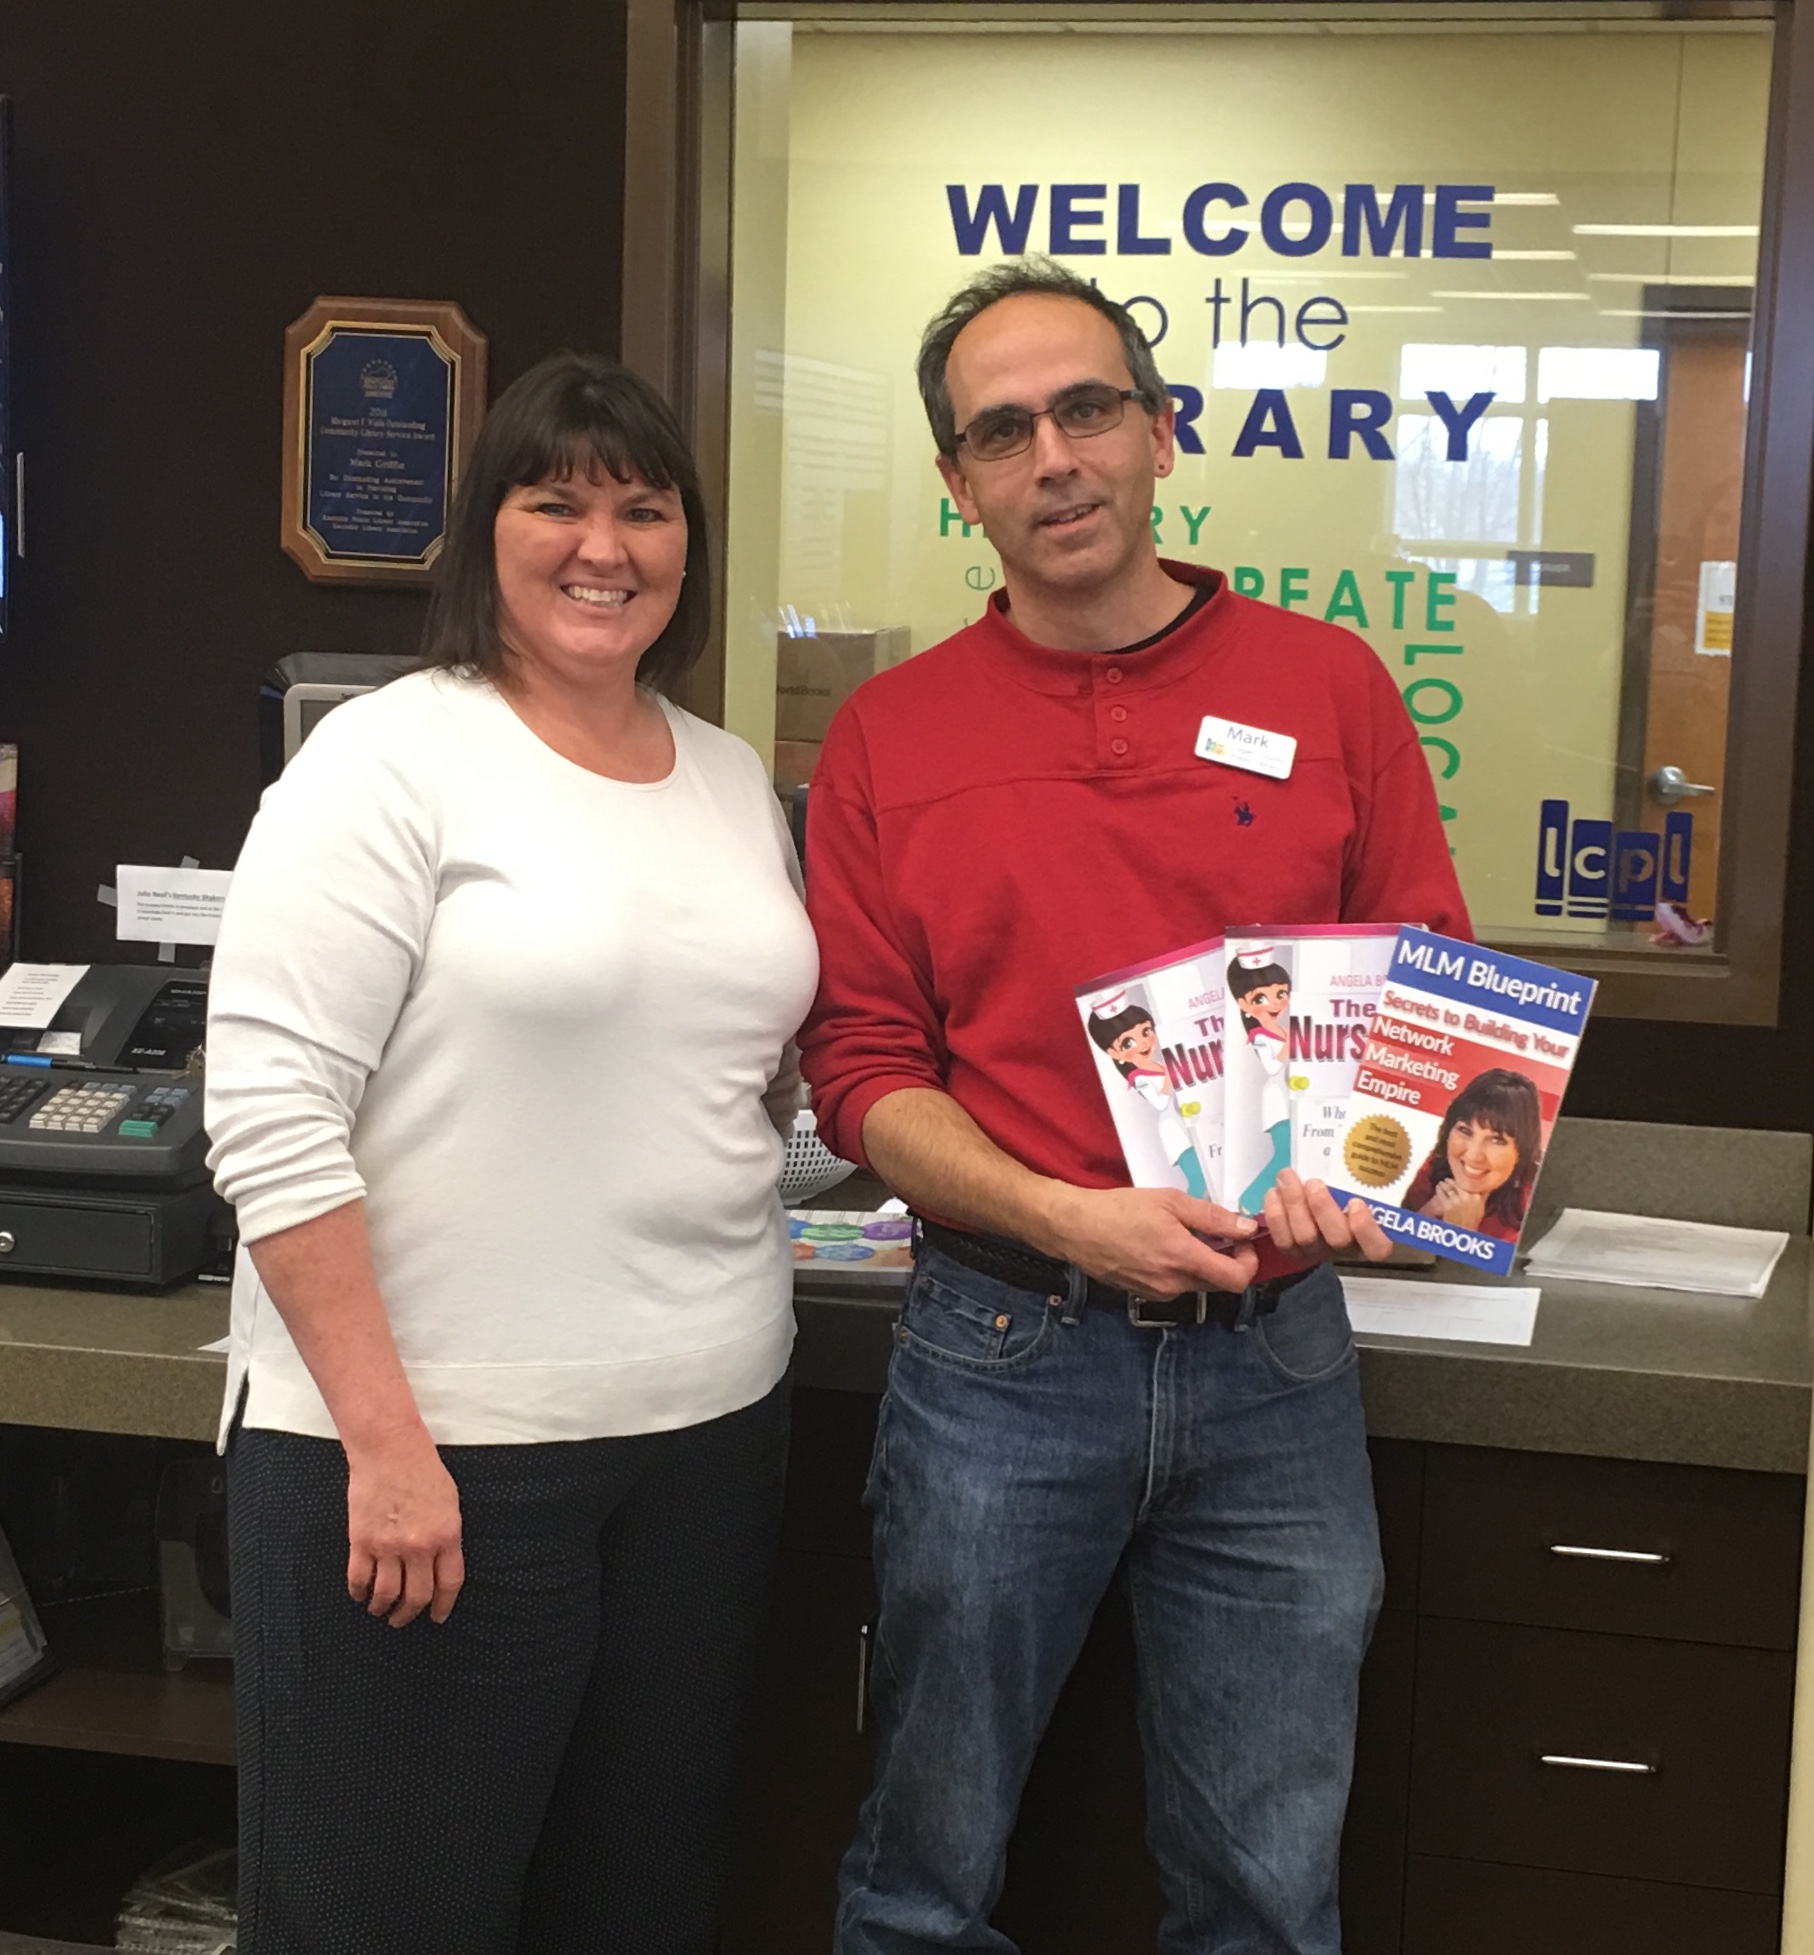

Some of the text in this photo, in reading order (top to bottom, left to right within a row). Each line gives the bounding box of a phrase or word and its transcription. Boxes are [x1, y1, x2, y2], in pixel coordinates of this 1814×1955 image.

[945, 182, 1496, 259] WELCOME
[1091, 278, 1349, 351] o the
[1167, 384, 1497, 462] RARY
[1227, 726, 1269, 748] Mark
[1330, 975, 1373, 988] ANGELA
[1397, 940, 1582, 1015] MLM Blueprint
[1194, 1013, 1226, 1037] Th
[1330, 999, 1378, 1018] The
[1383, 990, 1570, 1058] Secrets to Building Your
[1289, 1015, 1368, 1063] Nurs
[1374, 1017, 1455, 1056] Network
[1162, 1038, 1226, 1092] Nur
[1357, 1071, 1422, 1105] Empire
[1366, 1043, 1460, 1090] Marketing
[1209, 1144, 1223, 1159] Fr
[1303, 1124, 1334, 1138] From
[1369, 1204, 1496, 1260] GELA BROOKS
